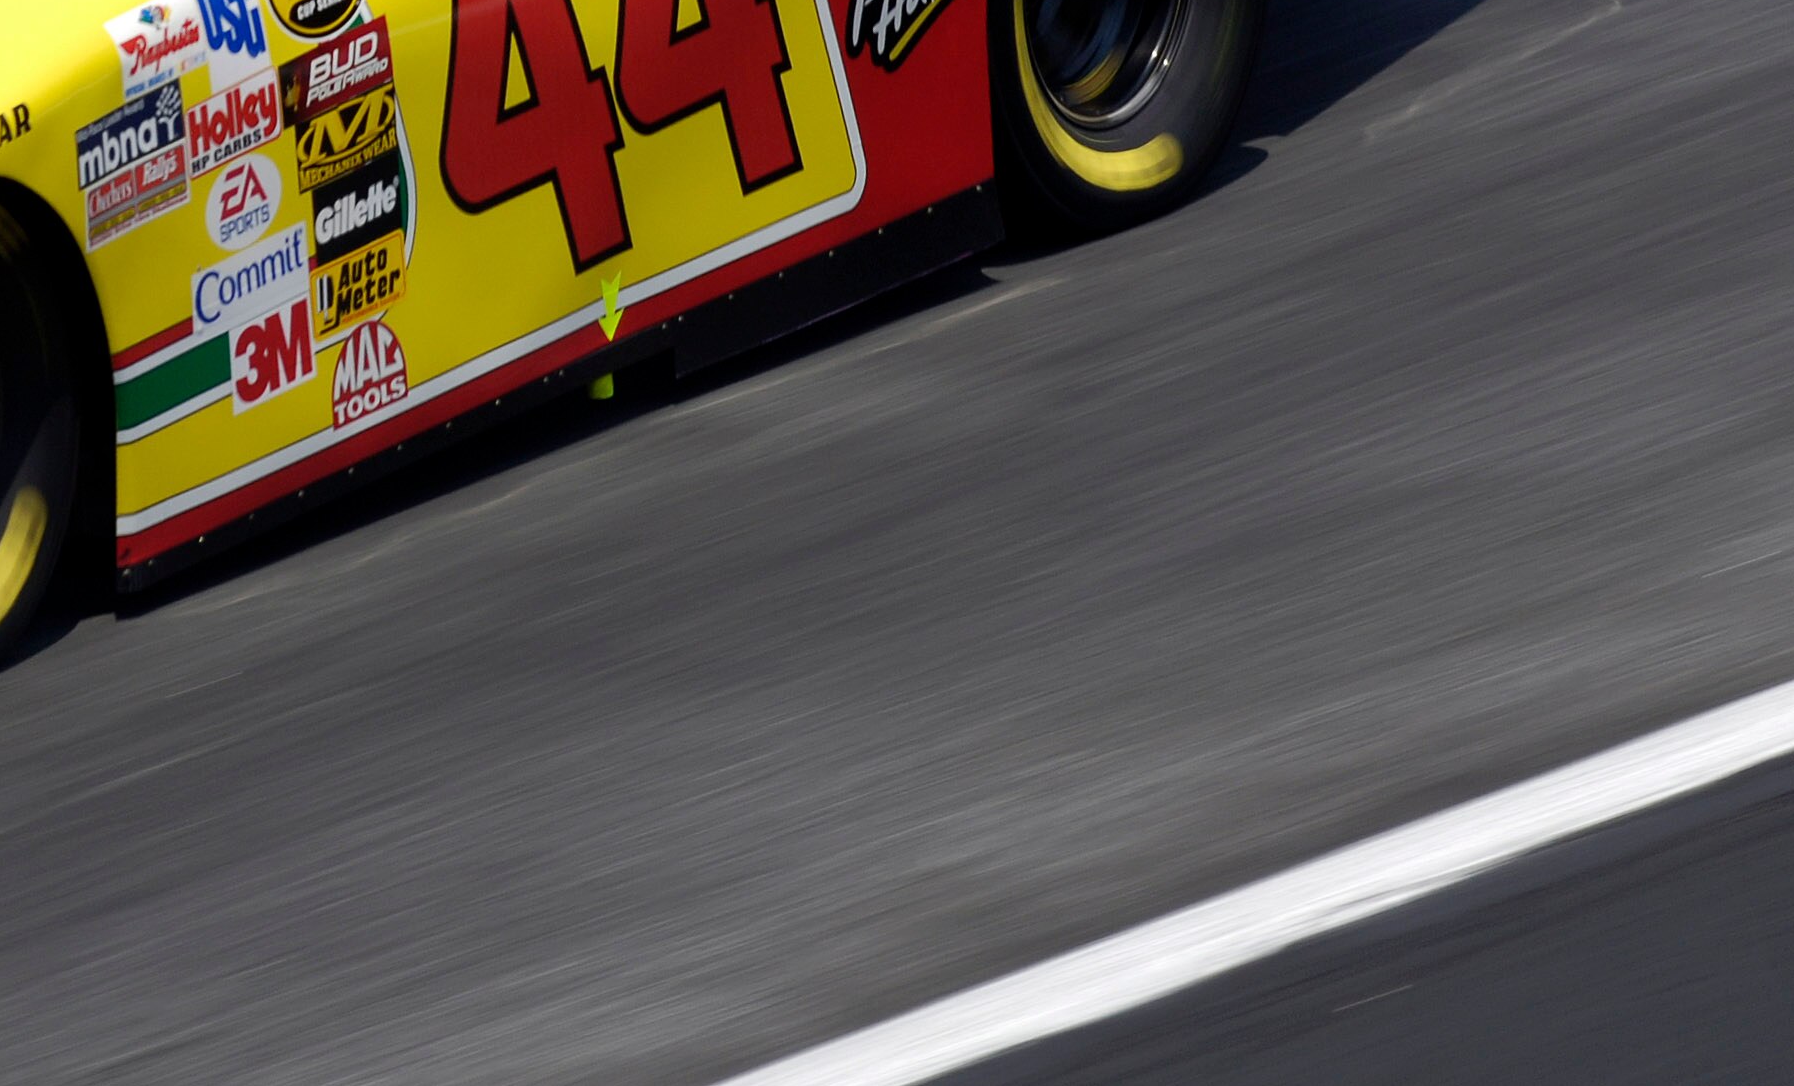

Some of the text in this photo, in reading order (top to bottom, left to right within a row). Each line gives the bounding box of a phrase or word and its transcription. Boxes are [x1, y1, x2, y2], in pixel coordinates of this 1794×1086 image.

[297, 0, 316, 21] CUP
[310, 31, 379, 88] BUD
[188, 82, 278, 159] Holley
[363, 127, 397, 163] WEAR
[79, 116, 159, 188] mbna
[192, 128, 262, 174] HP CARBS
[220, 162, 268, 221] EA
[315, 178, 397, 245] Gillette
[219, 203, 270, 243] SPORTS
[195, 227, 305, 324] Commit
[330, 269, 401, 326] Meter
[338, 248, 388, 292] Auto
[234, 299, 314, 404] 3M
[333, 322, 405, 400] MAC
[333, 374, 406, 425] TOOLS
